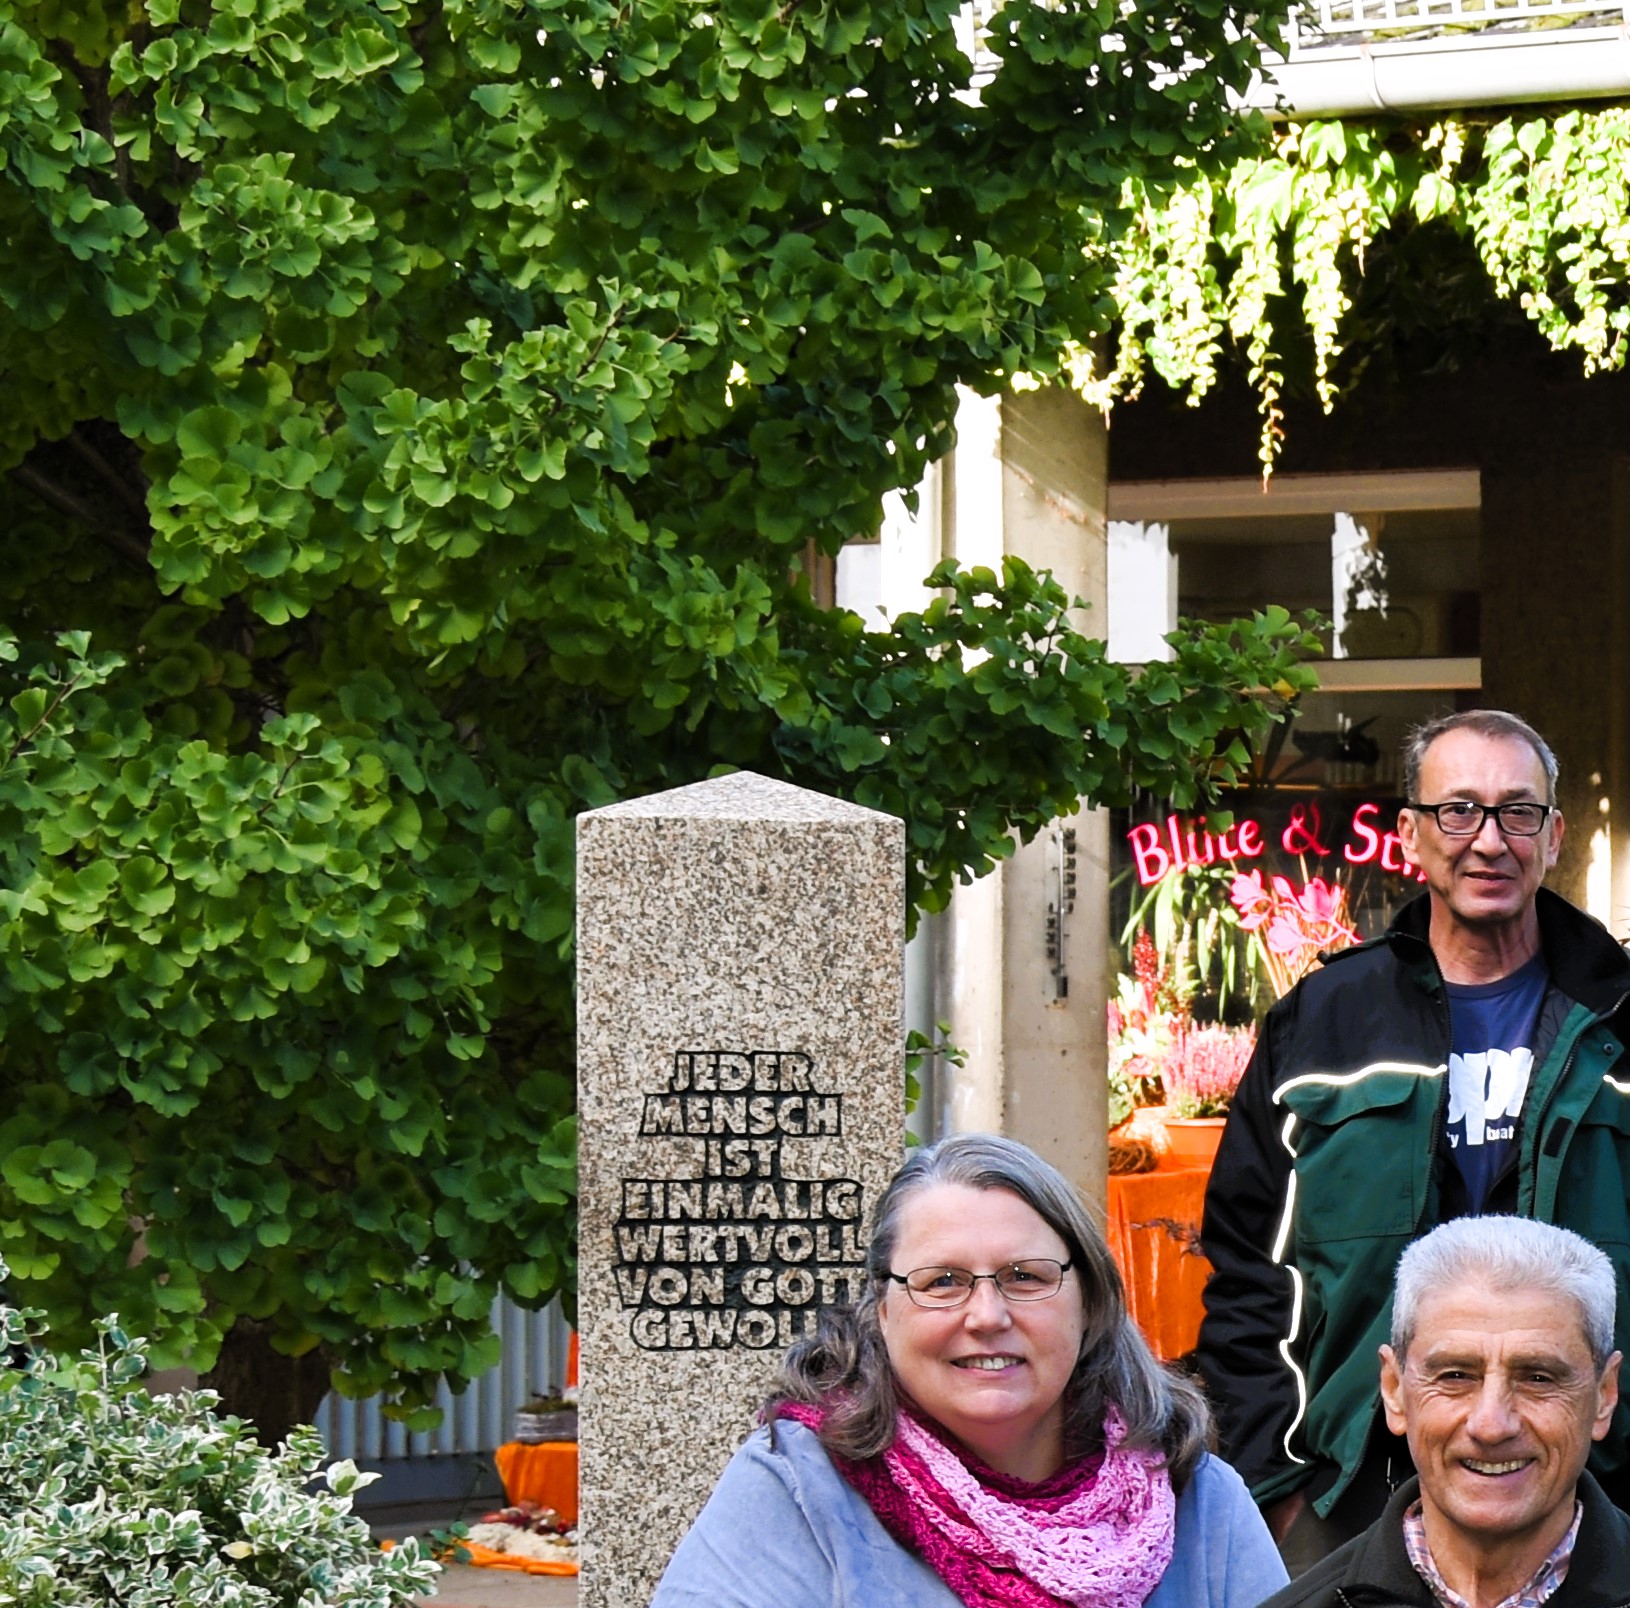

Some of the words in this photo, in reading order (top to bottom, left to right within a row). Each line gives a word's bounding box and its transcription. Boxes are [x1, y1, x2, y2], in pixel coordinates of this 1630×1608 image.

[1281, 797, 1332, 857] &
[671, 1053, 812, 1092] JEDER
[643, 1096, 839, 1135] MENSCH
[705, 1139, 778, 1177] IST
[623, 1182, 860, 1220] EINMALIG
[616, 1224, 866, 1262] WERTVOLL
[613, 1267, 725, 1305] VON
[741, 1266, 868, 1306] GOTT
[631, 1308, 818, 1349] GEWOL
